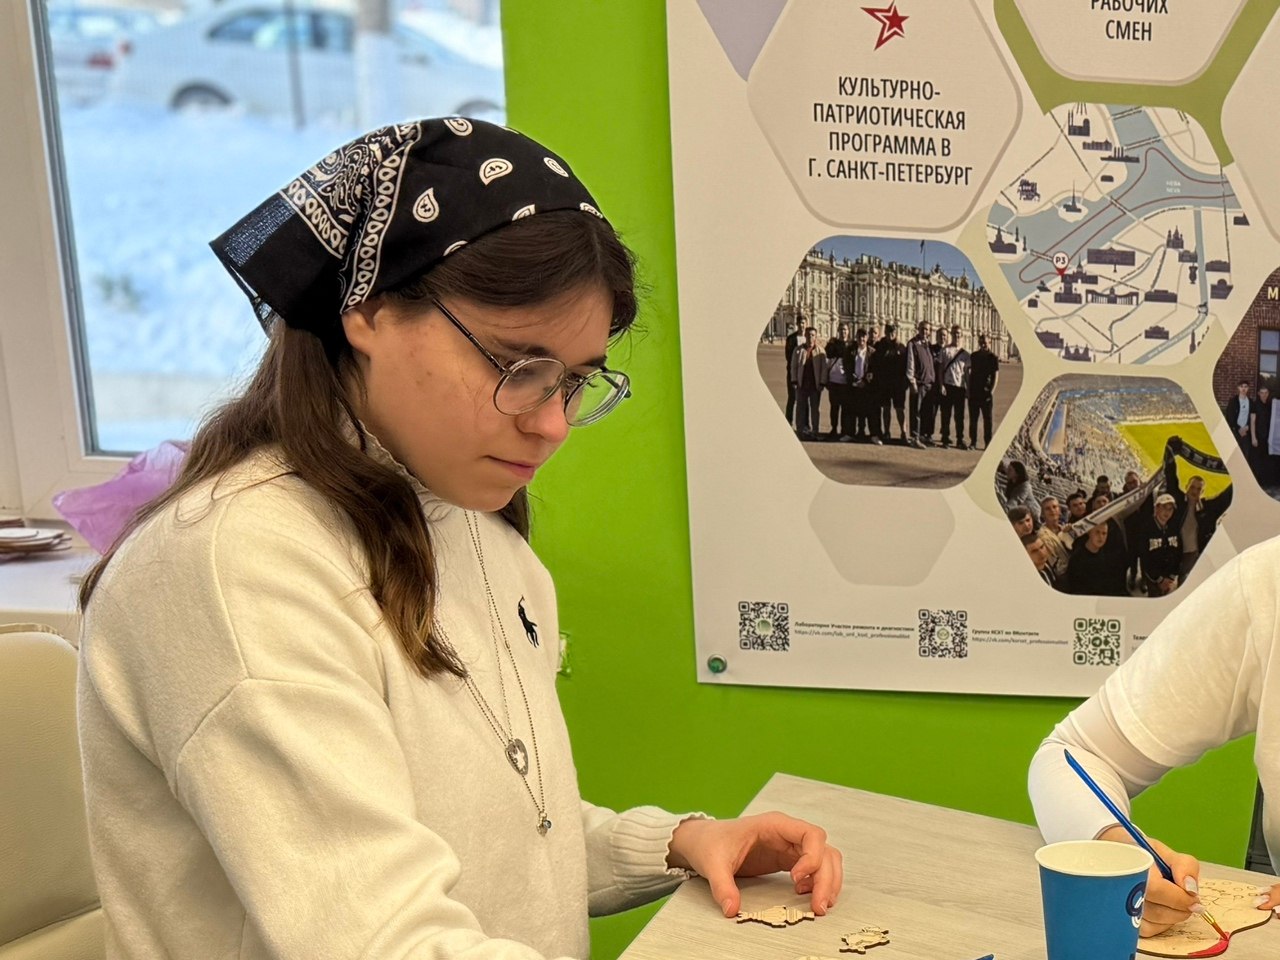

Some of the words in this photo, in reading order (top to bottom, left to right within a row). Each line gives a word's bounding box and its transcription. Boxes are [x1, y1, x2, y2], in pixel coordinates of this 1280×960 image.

[1106, 19, 1152, 41] СМЕН
[838, 76, 941, 100] КУЛЬТУРНО-
[813, 103, 966, 130] ПАТРИОТИЧЕСКАЯ
[829, 131, 937, 157] ПРОГРАММА
[941, 138, 951, 157] В
[808, 158, 821, 178] Г.
[826, 159, 973, 186] САНКТ-ПЕТЕРБУРГ
